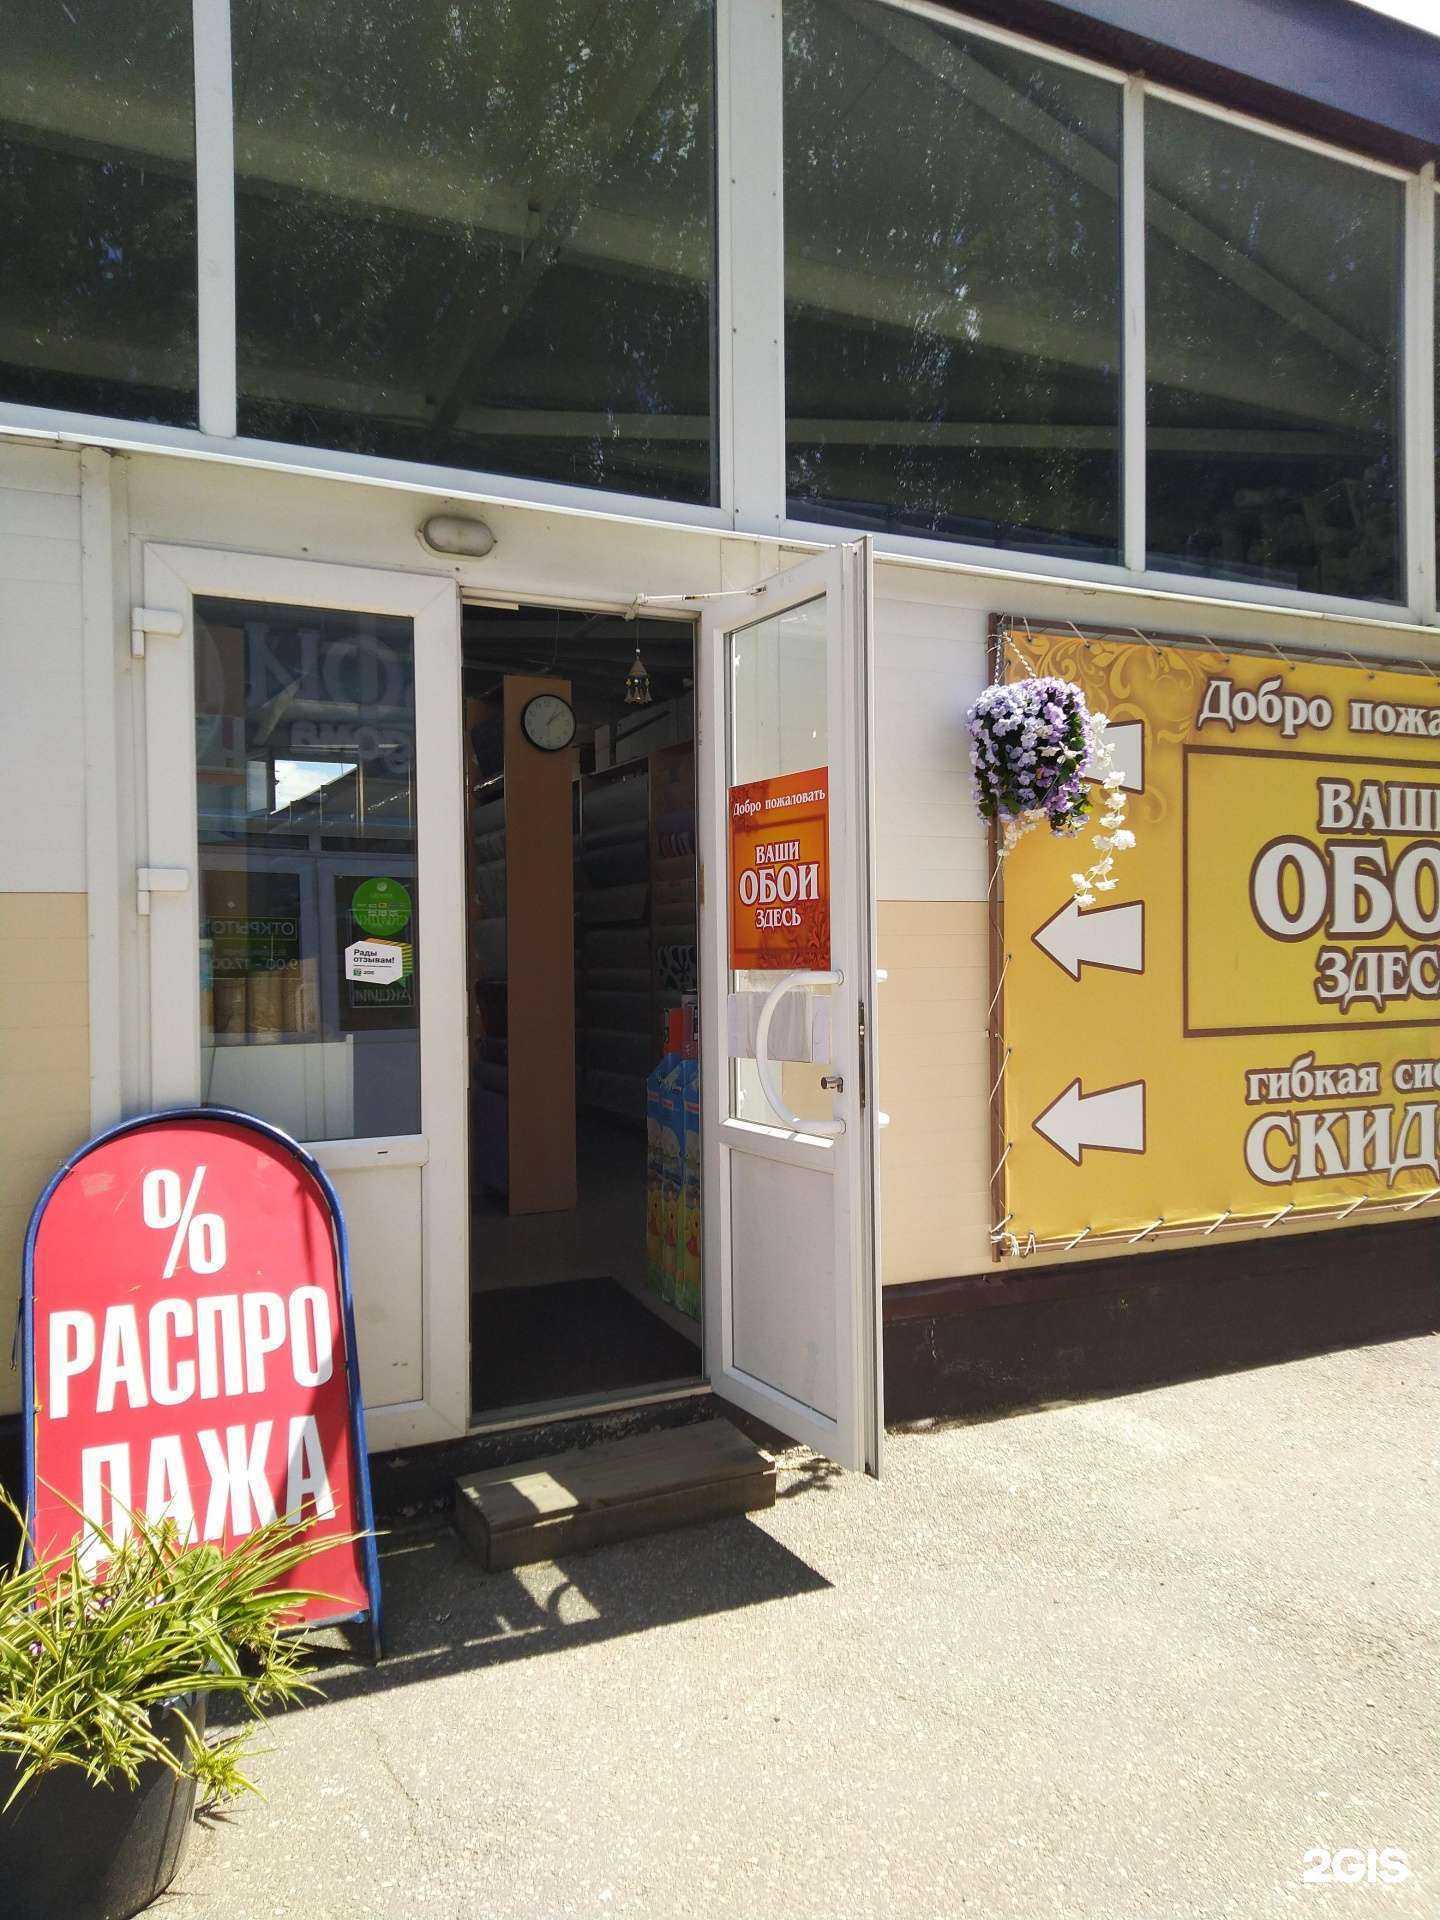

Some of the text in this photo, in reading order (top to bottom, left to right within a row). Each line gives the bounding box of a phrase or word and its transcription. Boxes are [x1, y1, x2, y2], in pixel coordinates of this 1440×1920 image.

[1198, 677, 1440, 737] Добро пожа
[733, 789, 826, 816] Добро пожаловать
[1318, 781, 1440, 832] ВАШ
[755, 841, 800, 864] ВАШИ
[739, 863, 819, 905] ОБОИ
[1251, 840, 1440, 938] ОБО
[755, 908, 801, 931] ЗДЕСЬ
[353, 948, 378, 958] Рады
[353, 956, 395, 964] отзывам!
[1317, 950, 1440, 1009] ЗДЕС
[1247, 1055, 1379, 1100] гибкая
[142, 1165, 228, 1280] %
[49, 1284, 335, 1420] РАСПРО
